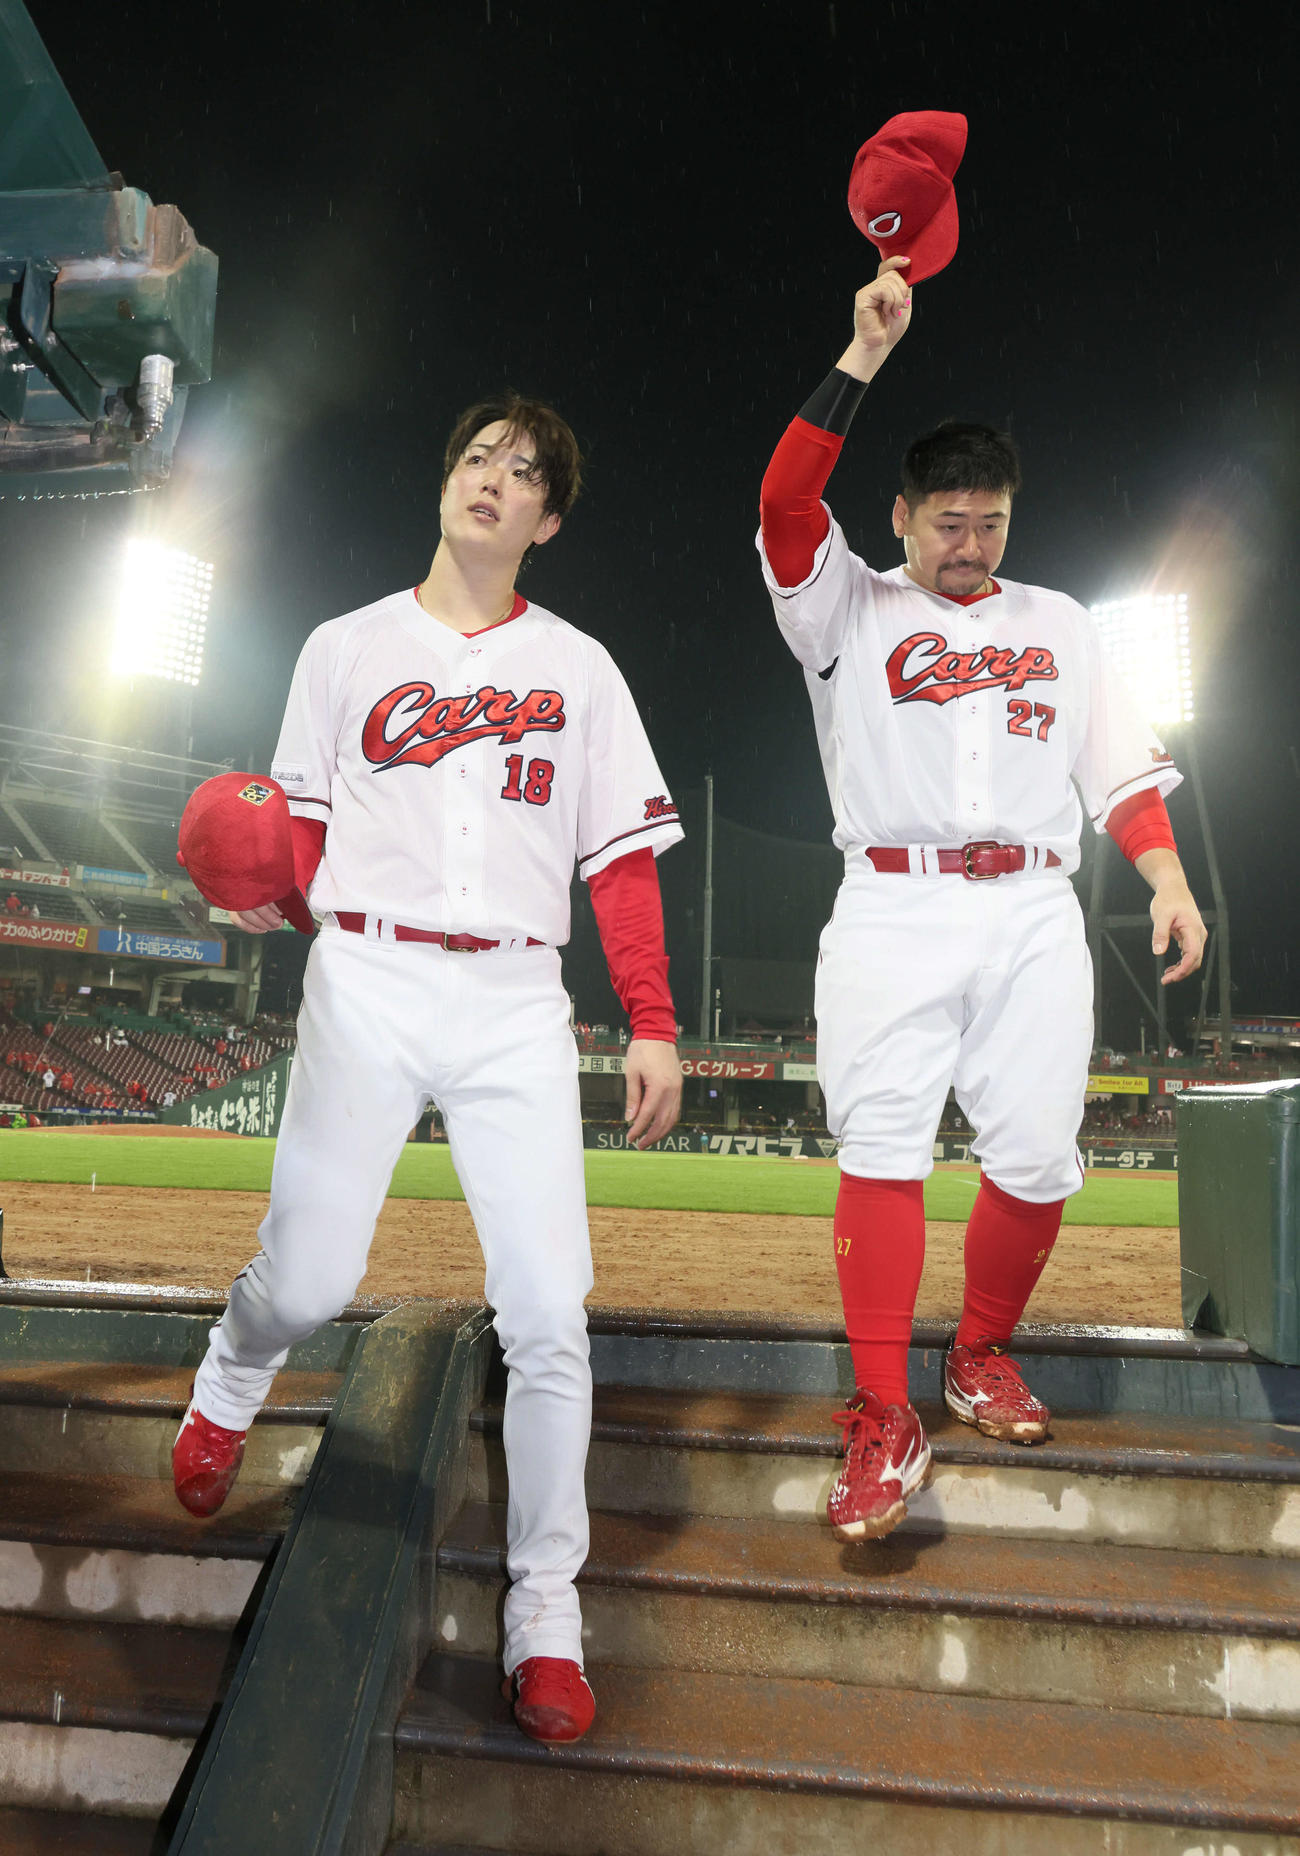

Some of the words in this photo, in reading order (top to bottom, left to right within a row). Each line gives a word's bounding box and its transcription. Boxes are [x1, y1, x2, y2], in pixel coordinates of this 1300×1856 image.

[885, 632, 1059, 706] Carp
[361, 681, 566, 773] Carp
[1007, 699, 1056, 742] 27
[501, 753, 556, 806] 18
[136, 940, 203, 960] 中国ろうきん
[597, 1133, 690, 1151] SUNAR
[709, 1135, 803, 1157] クマヒラ
[1088, 1149, 1155, 1169] トータテ
[837, 1237, 852, 1257] 27
